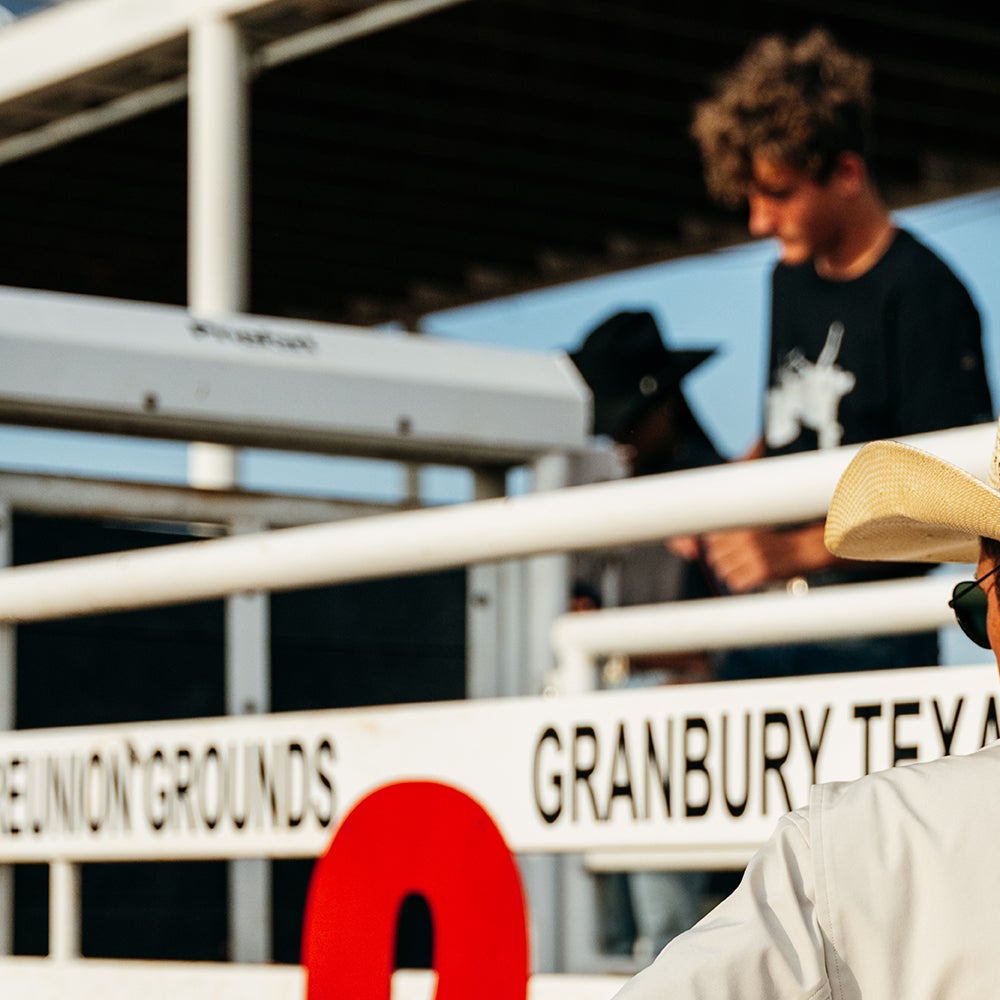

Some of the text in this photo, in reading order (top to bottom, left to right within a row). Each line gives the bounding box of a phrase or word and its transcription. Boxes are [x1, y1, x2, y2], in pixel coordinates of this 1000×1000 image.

[0, 739, 335, 834] EUNION GROUNDS
[533, 696, 1000, 824] GRANBURY TEX
